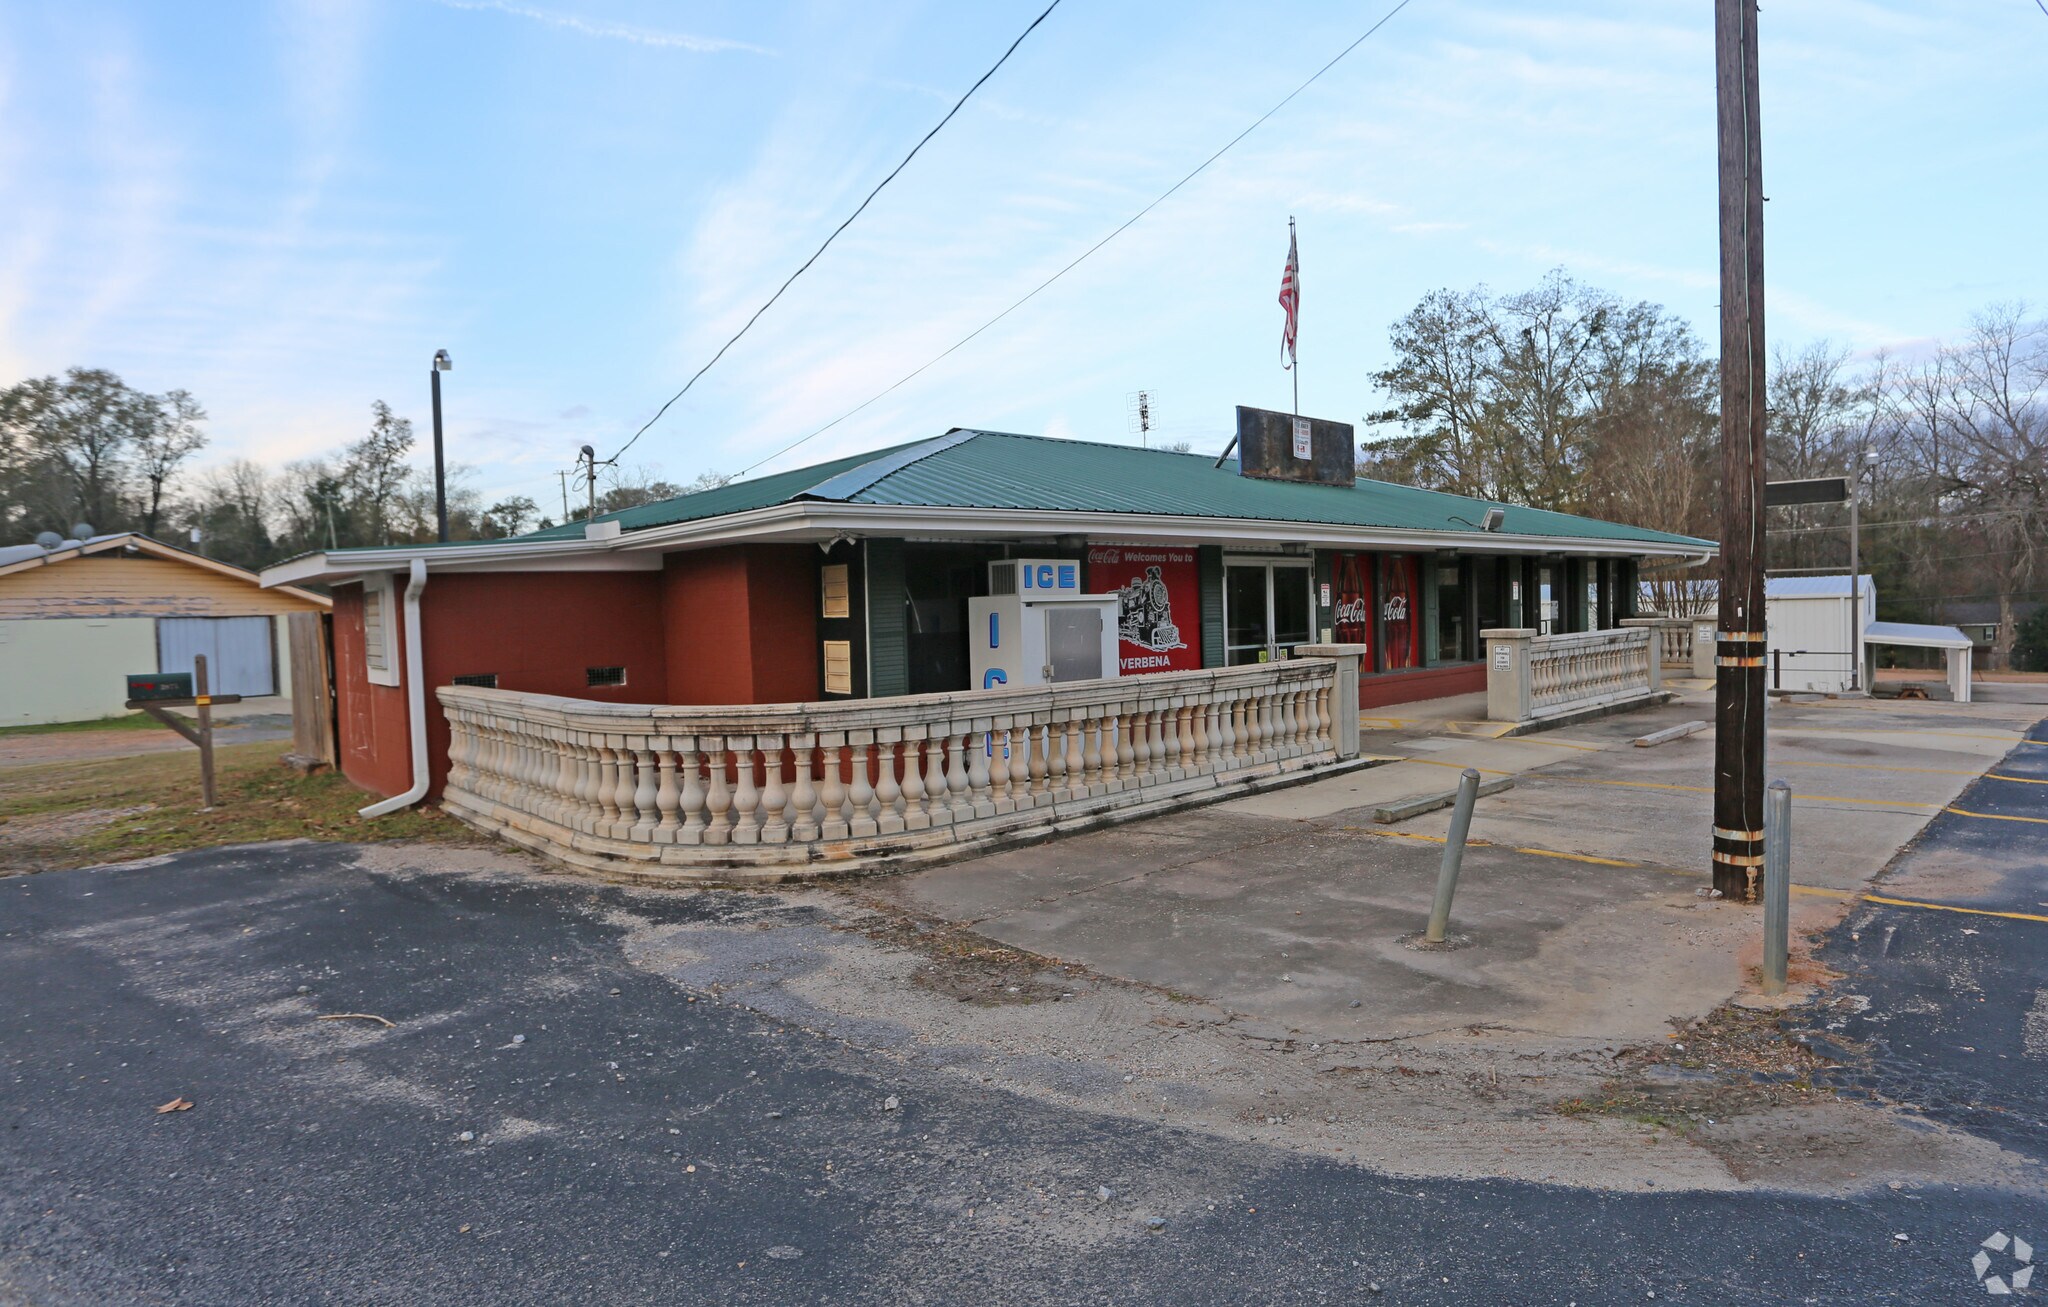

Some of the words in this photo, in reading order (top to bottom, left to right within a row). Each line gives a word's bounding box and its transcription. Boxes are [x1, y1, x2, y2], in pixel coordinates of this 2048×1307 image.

[1125, 552, 1166, 562] Welcomes
[1169, 553, 1182, 562] You
[1185, 553, 1193, 562] to
[1024, 564, 1075, 589] ICE
[1120, 655, 1170, 669] VERBENA
